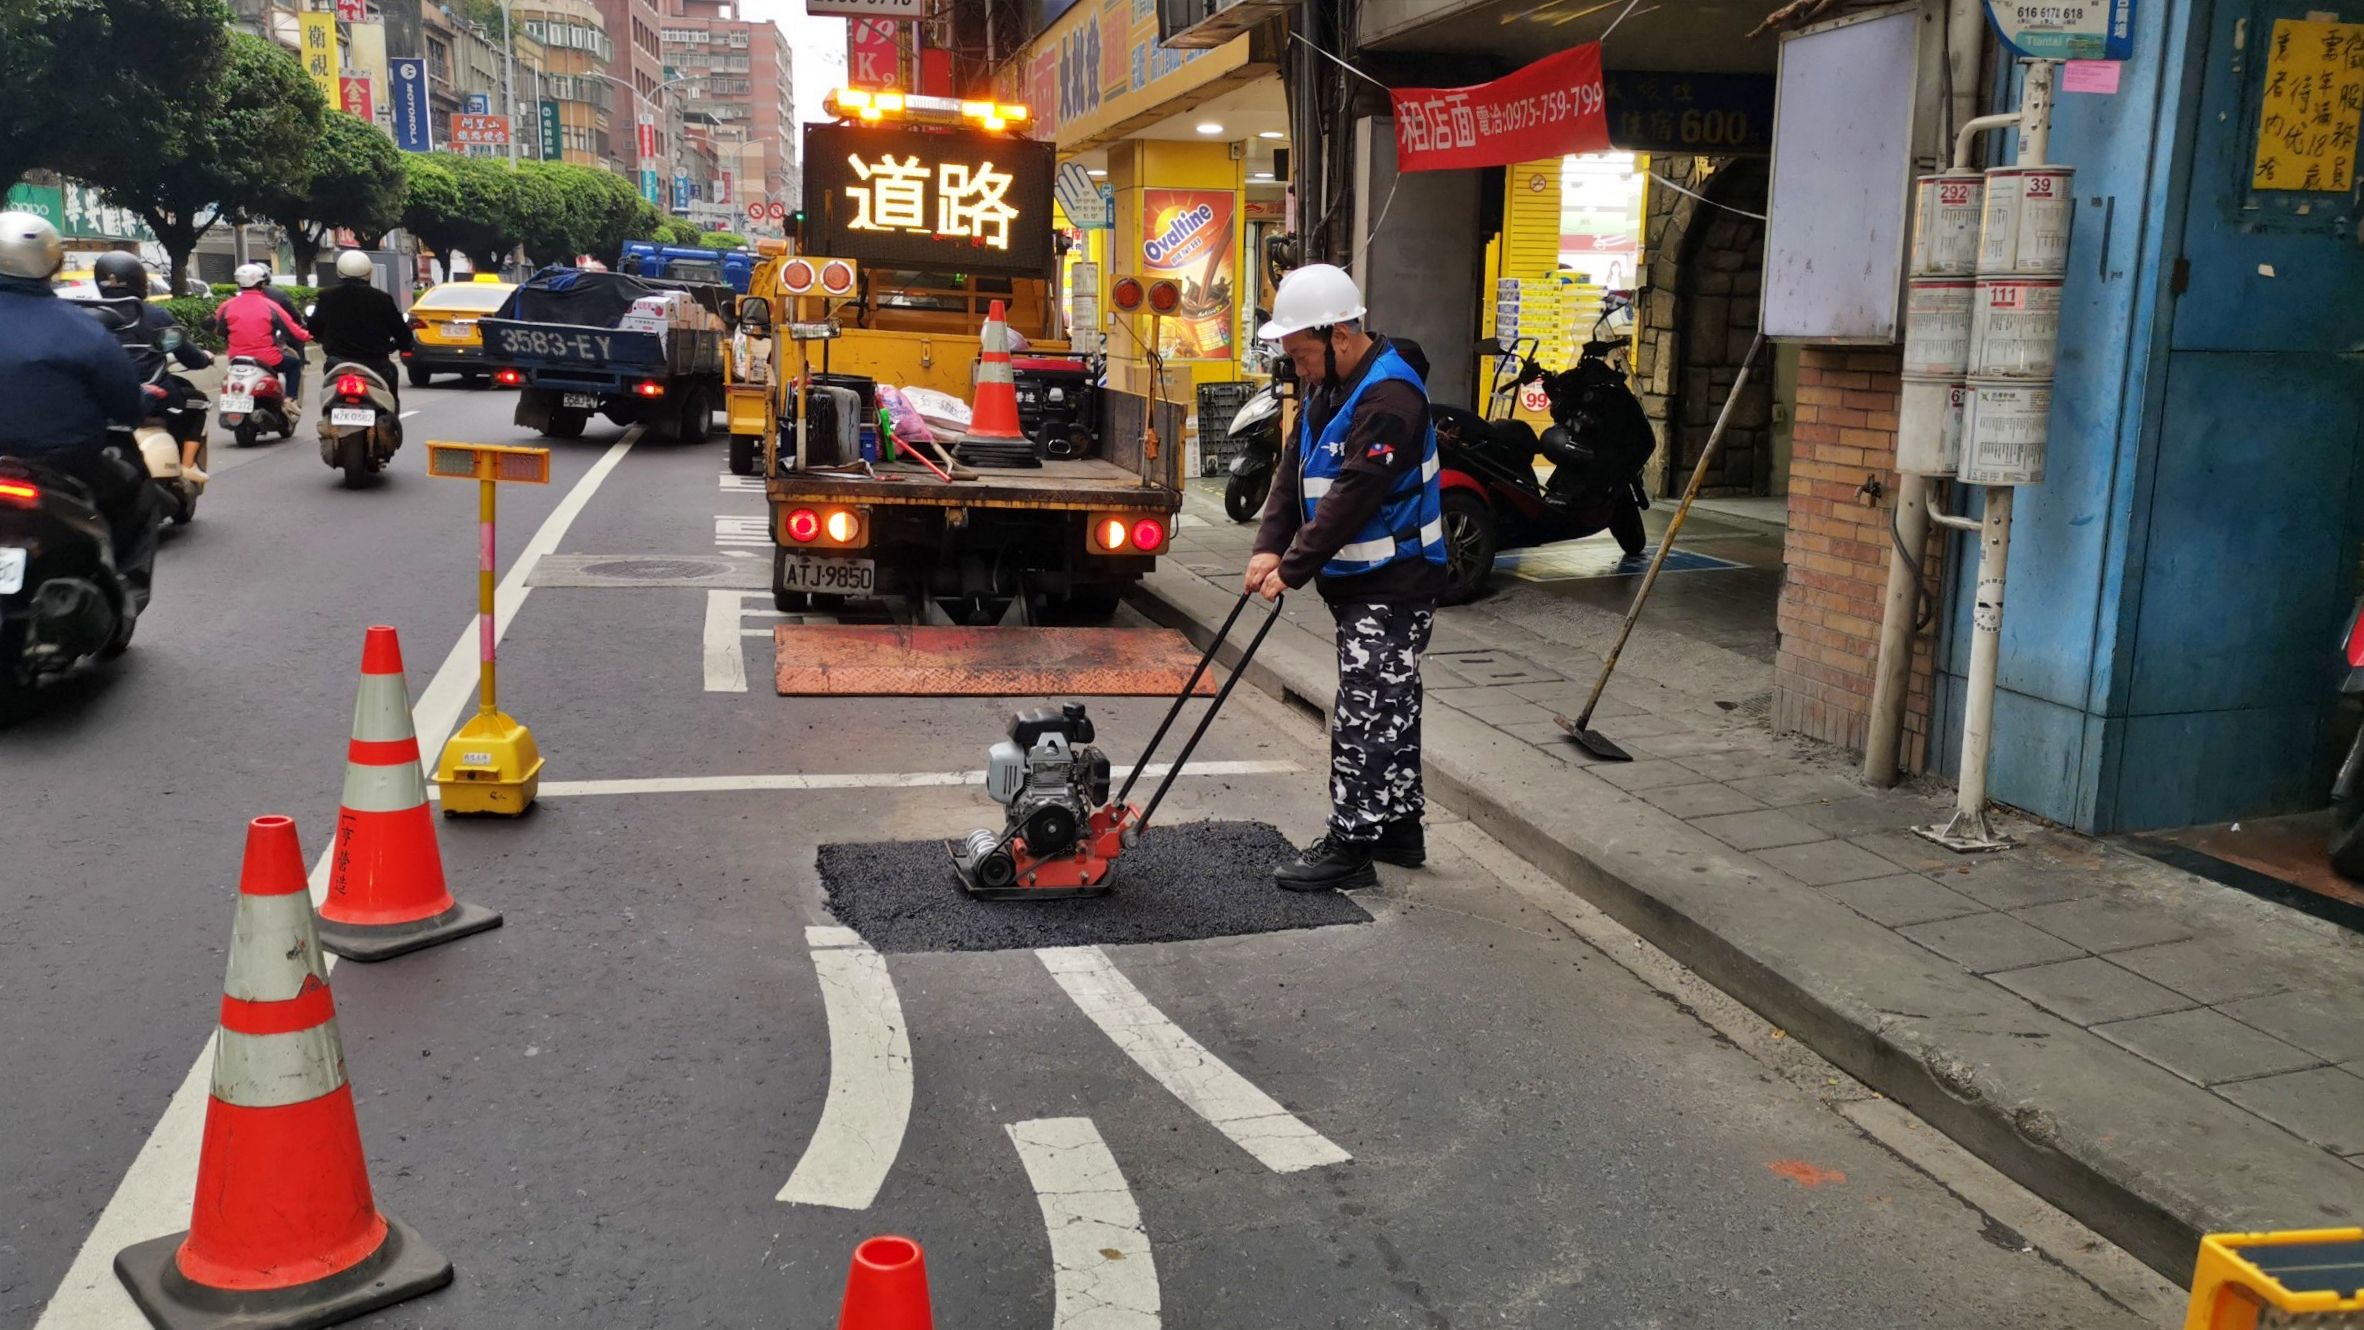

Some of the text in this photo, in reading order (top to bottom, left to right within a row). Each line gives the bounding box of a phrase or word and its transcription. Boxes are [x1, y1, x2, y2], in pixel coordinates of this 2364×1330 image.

[2018, 7, 2037, 18] 616
[2064, 8, 2083, 19] 618
[406, 83, 418, 145] MOTOROLA
[1398, 93, 1476, 153] 租店面
[1940, 186, 1968, 199] 292
[2030, 178, 2051, 191] 39
[846, 153, 1019, 249] 道路
[1145, 204, 1212, 261] Ovaltine
[1991, 288, 2016, 301] 111
[502, 329, 612, 360] 3583-EY
